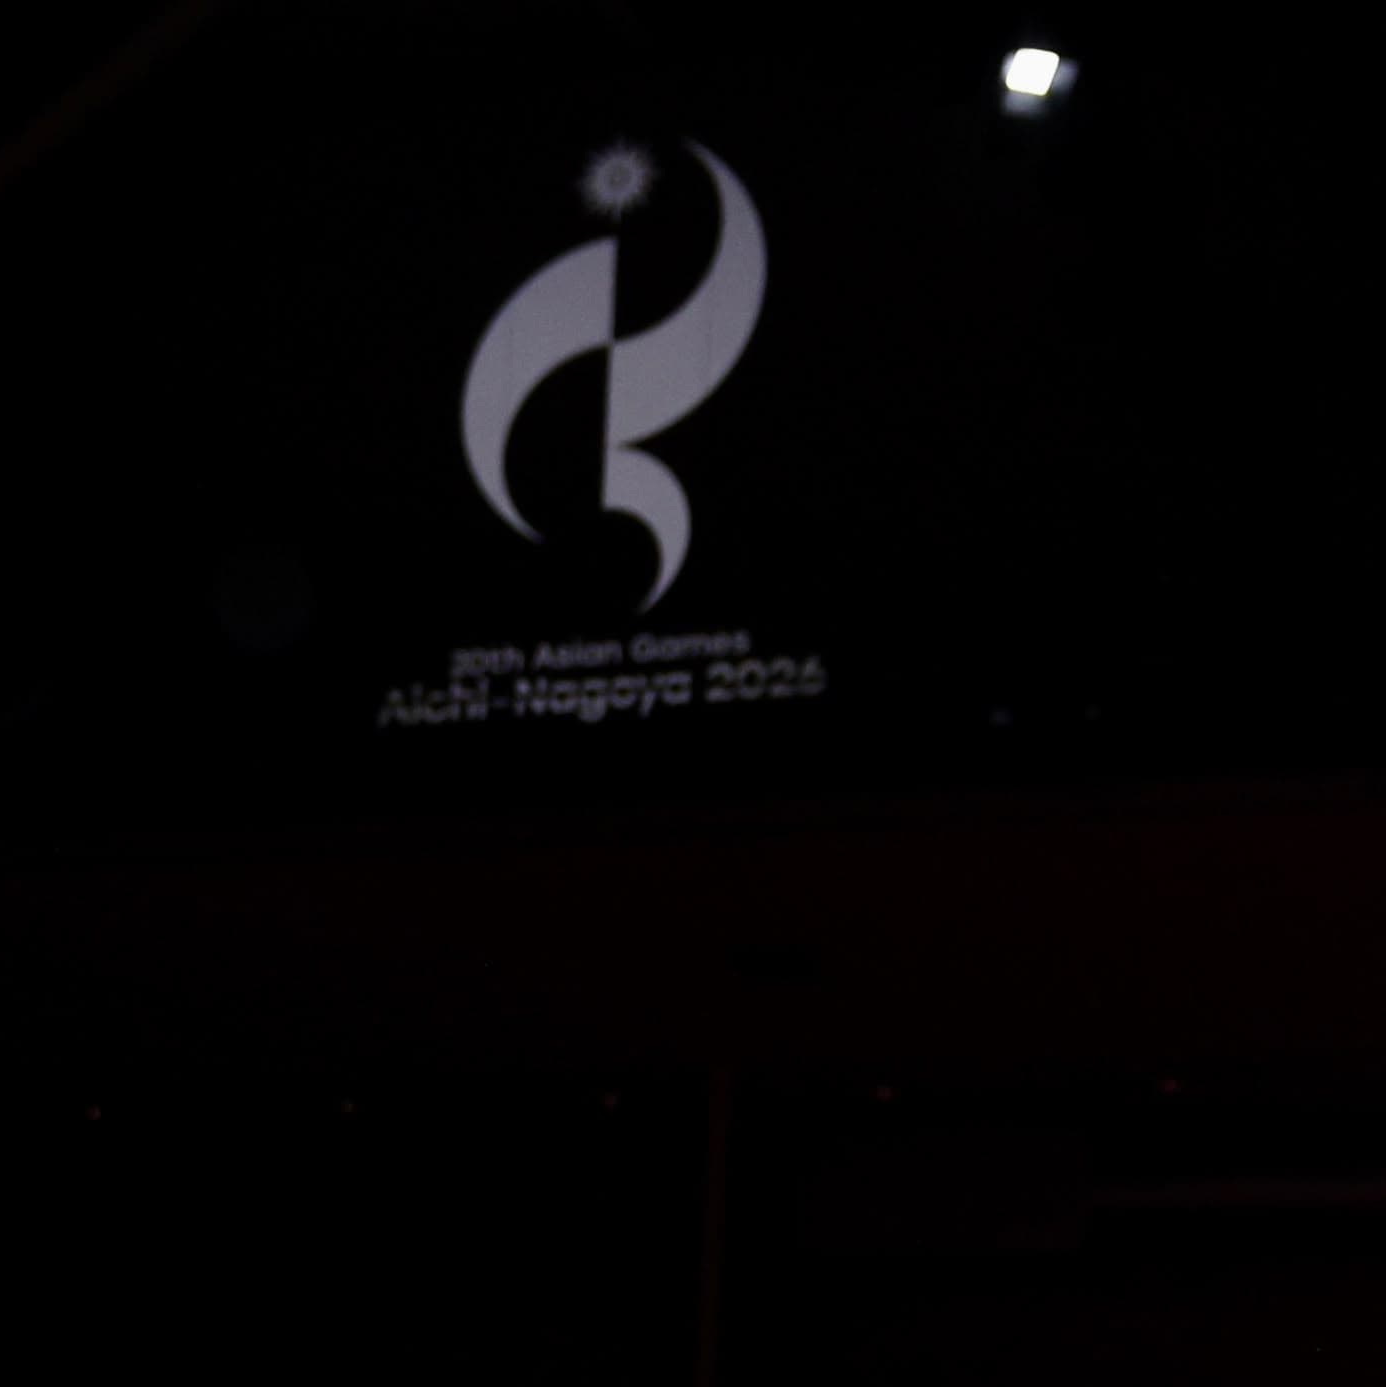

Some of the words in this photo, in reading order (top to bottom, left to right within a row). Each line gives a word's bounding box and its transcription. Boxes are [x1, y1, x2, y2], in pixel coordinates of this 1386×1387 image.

[533, 640, 623, 671] Asian
[630, 629, 751, 663] Games
[377, 669, 692, 724] Aichi-Nagoya
[704, 652, 828, 702] 2026
